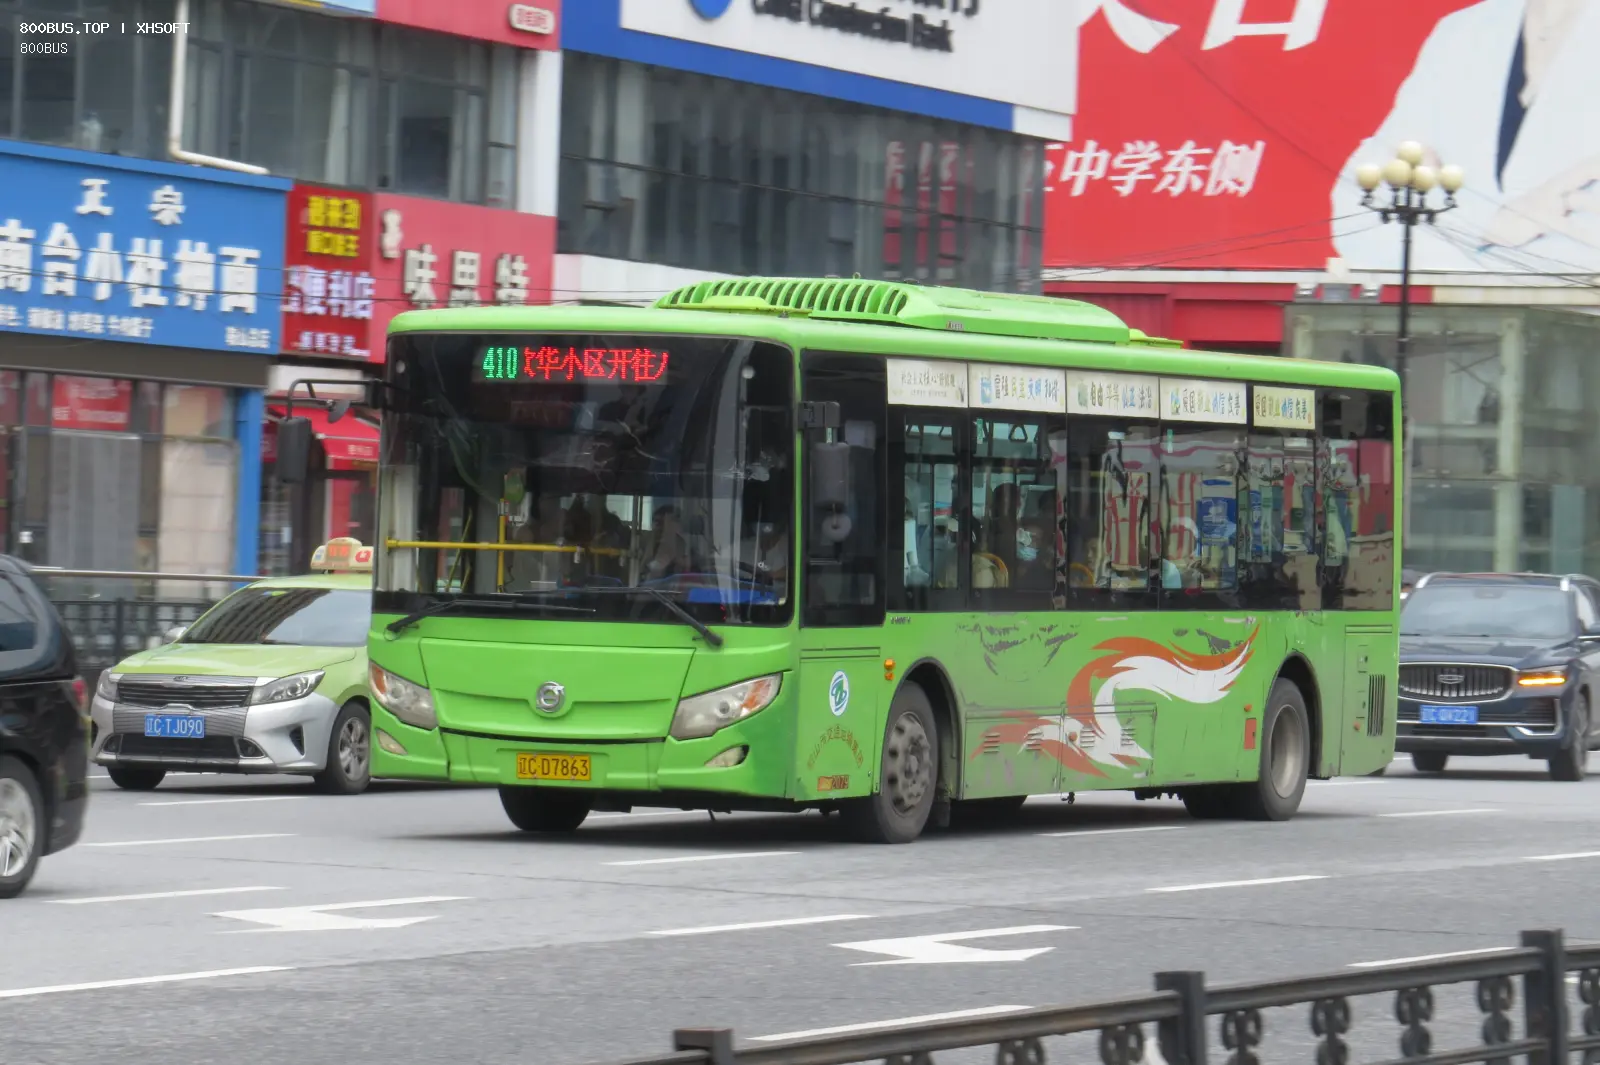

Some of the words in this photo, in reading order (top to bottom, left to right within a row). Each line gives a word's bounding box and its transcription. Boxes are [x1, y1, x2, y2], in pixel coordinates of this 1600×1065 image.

[483, 347, 518, 379] 410
[523, 346, 669, 382] 华小区开往
